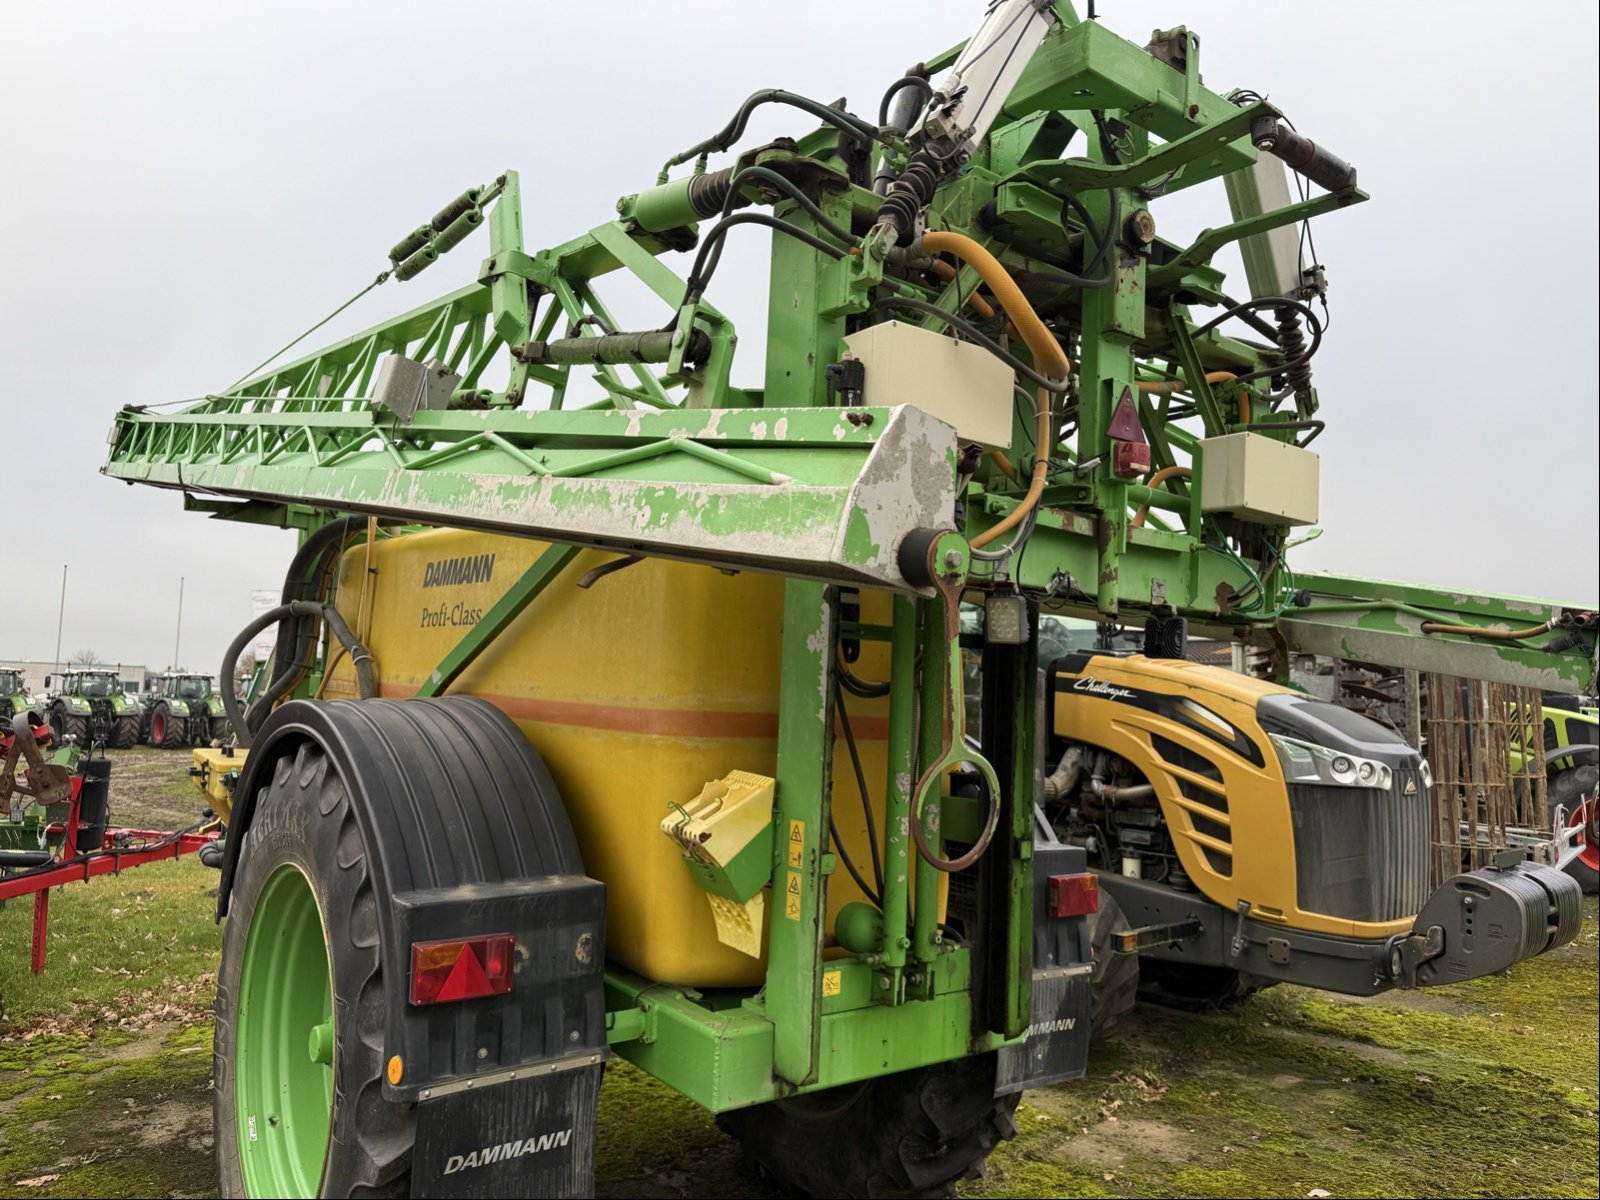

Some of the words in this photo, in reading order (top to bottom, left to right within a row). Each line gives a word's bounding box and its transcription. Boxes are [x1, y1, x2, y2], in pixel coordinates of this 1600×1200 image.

[423, 553, 496, 588] DAMMANN
[420, 601, 482, 628] Profi-Class
[1073, 675, 1138, 700] Challenger
[443, 1128, 573, 1175] DAMMANN
